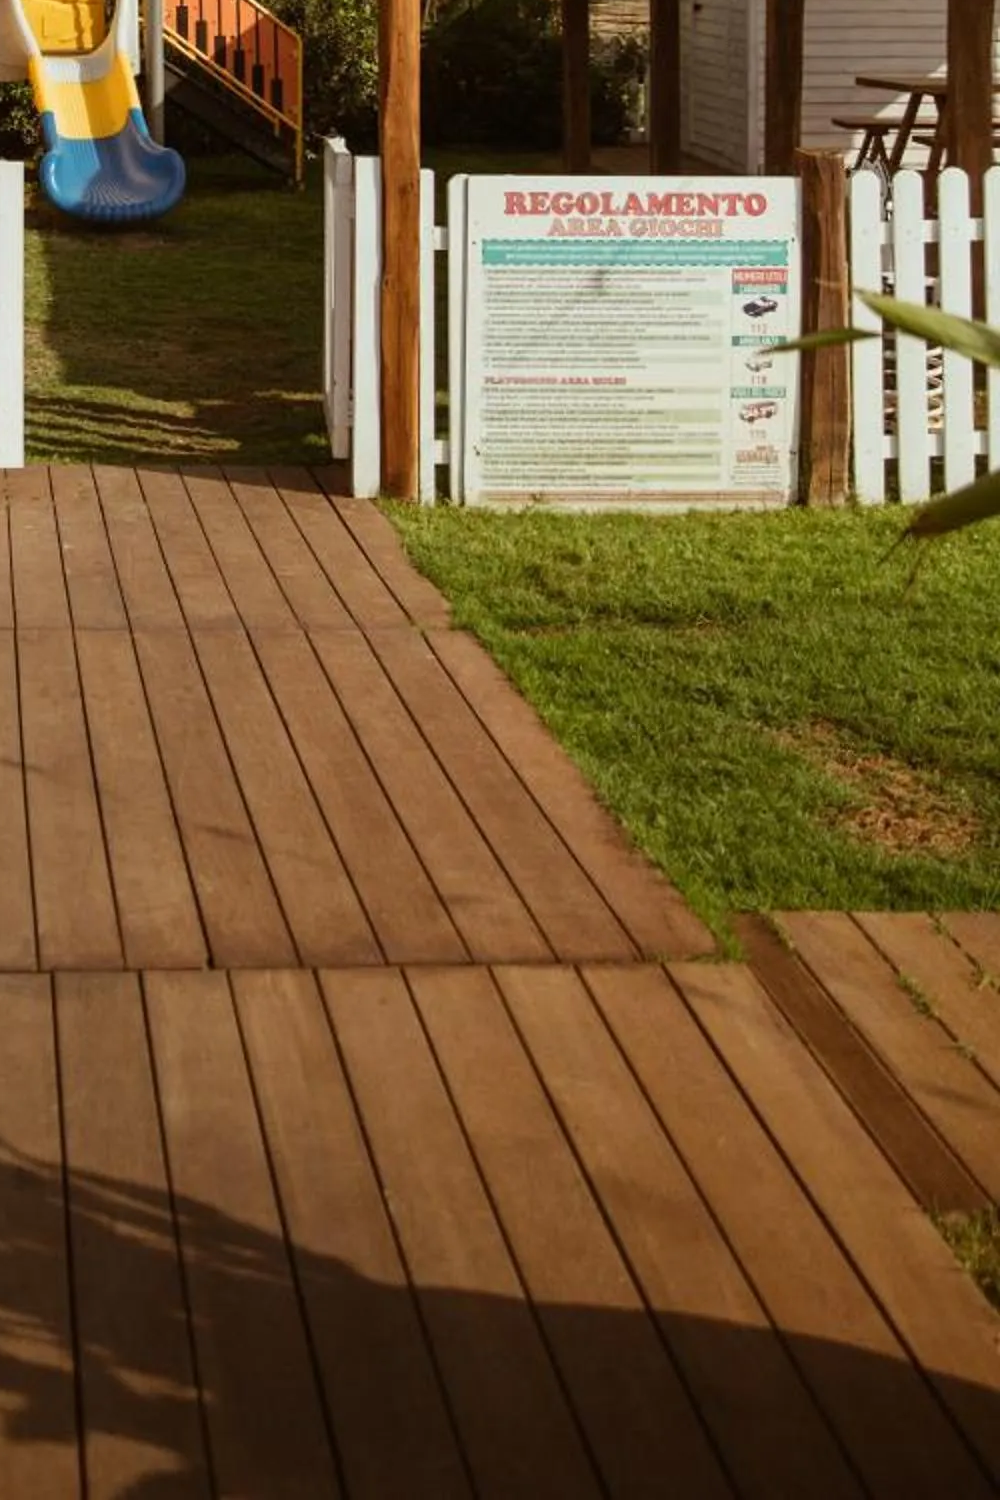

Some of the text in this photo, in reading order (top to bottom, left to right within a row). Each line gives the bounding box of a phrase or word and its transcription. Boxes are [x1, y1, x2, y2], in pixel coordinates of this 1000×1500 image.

[504, 192, 767, 216] REGOLAMENTO
[548, 219, 724, 238] AREA GIOCHI
